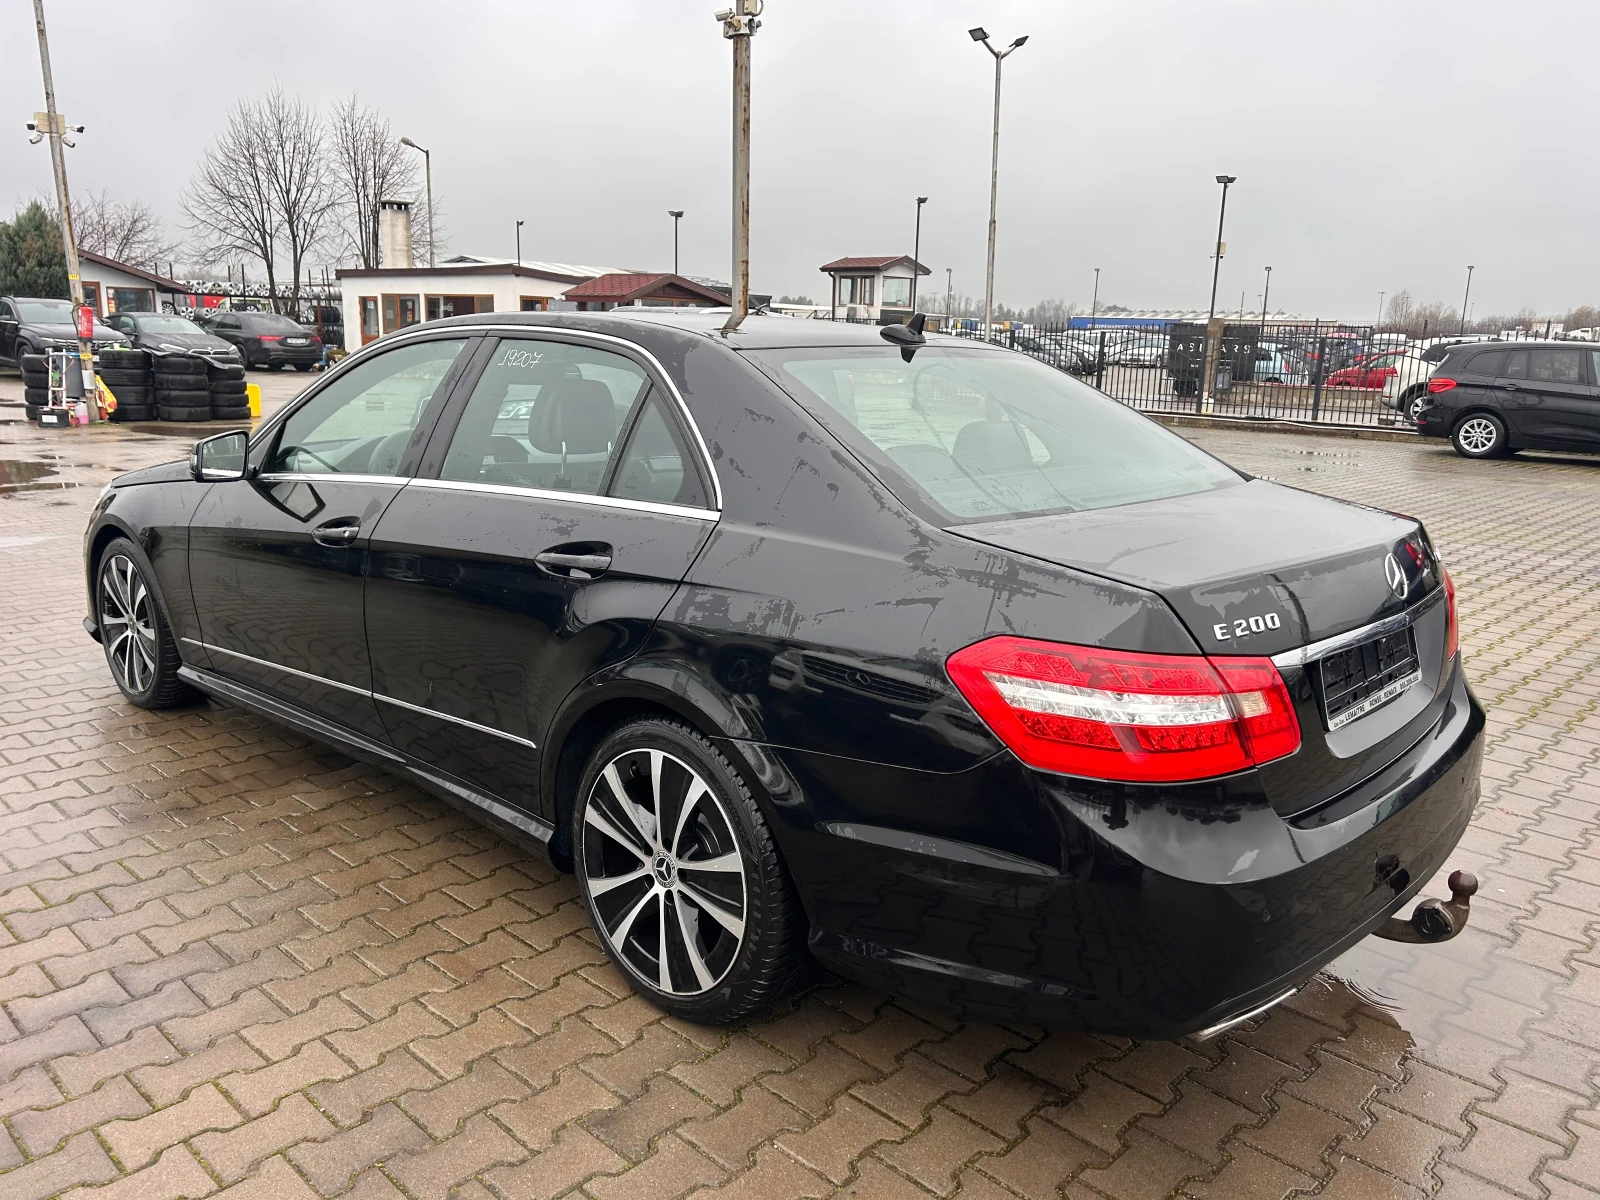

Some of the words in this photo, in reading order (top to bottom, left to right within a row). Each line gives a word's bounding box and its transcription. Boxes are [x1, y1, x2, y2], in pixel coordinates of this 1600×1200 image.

[497, 348, 544, 369] 19207
[1212, 623, 1231, 641] E
[1233, 612, 1281, 637] 200
